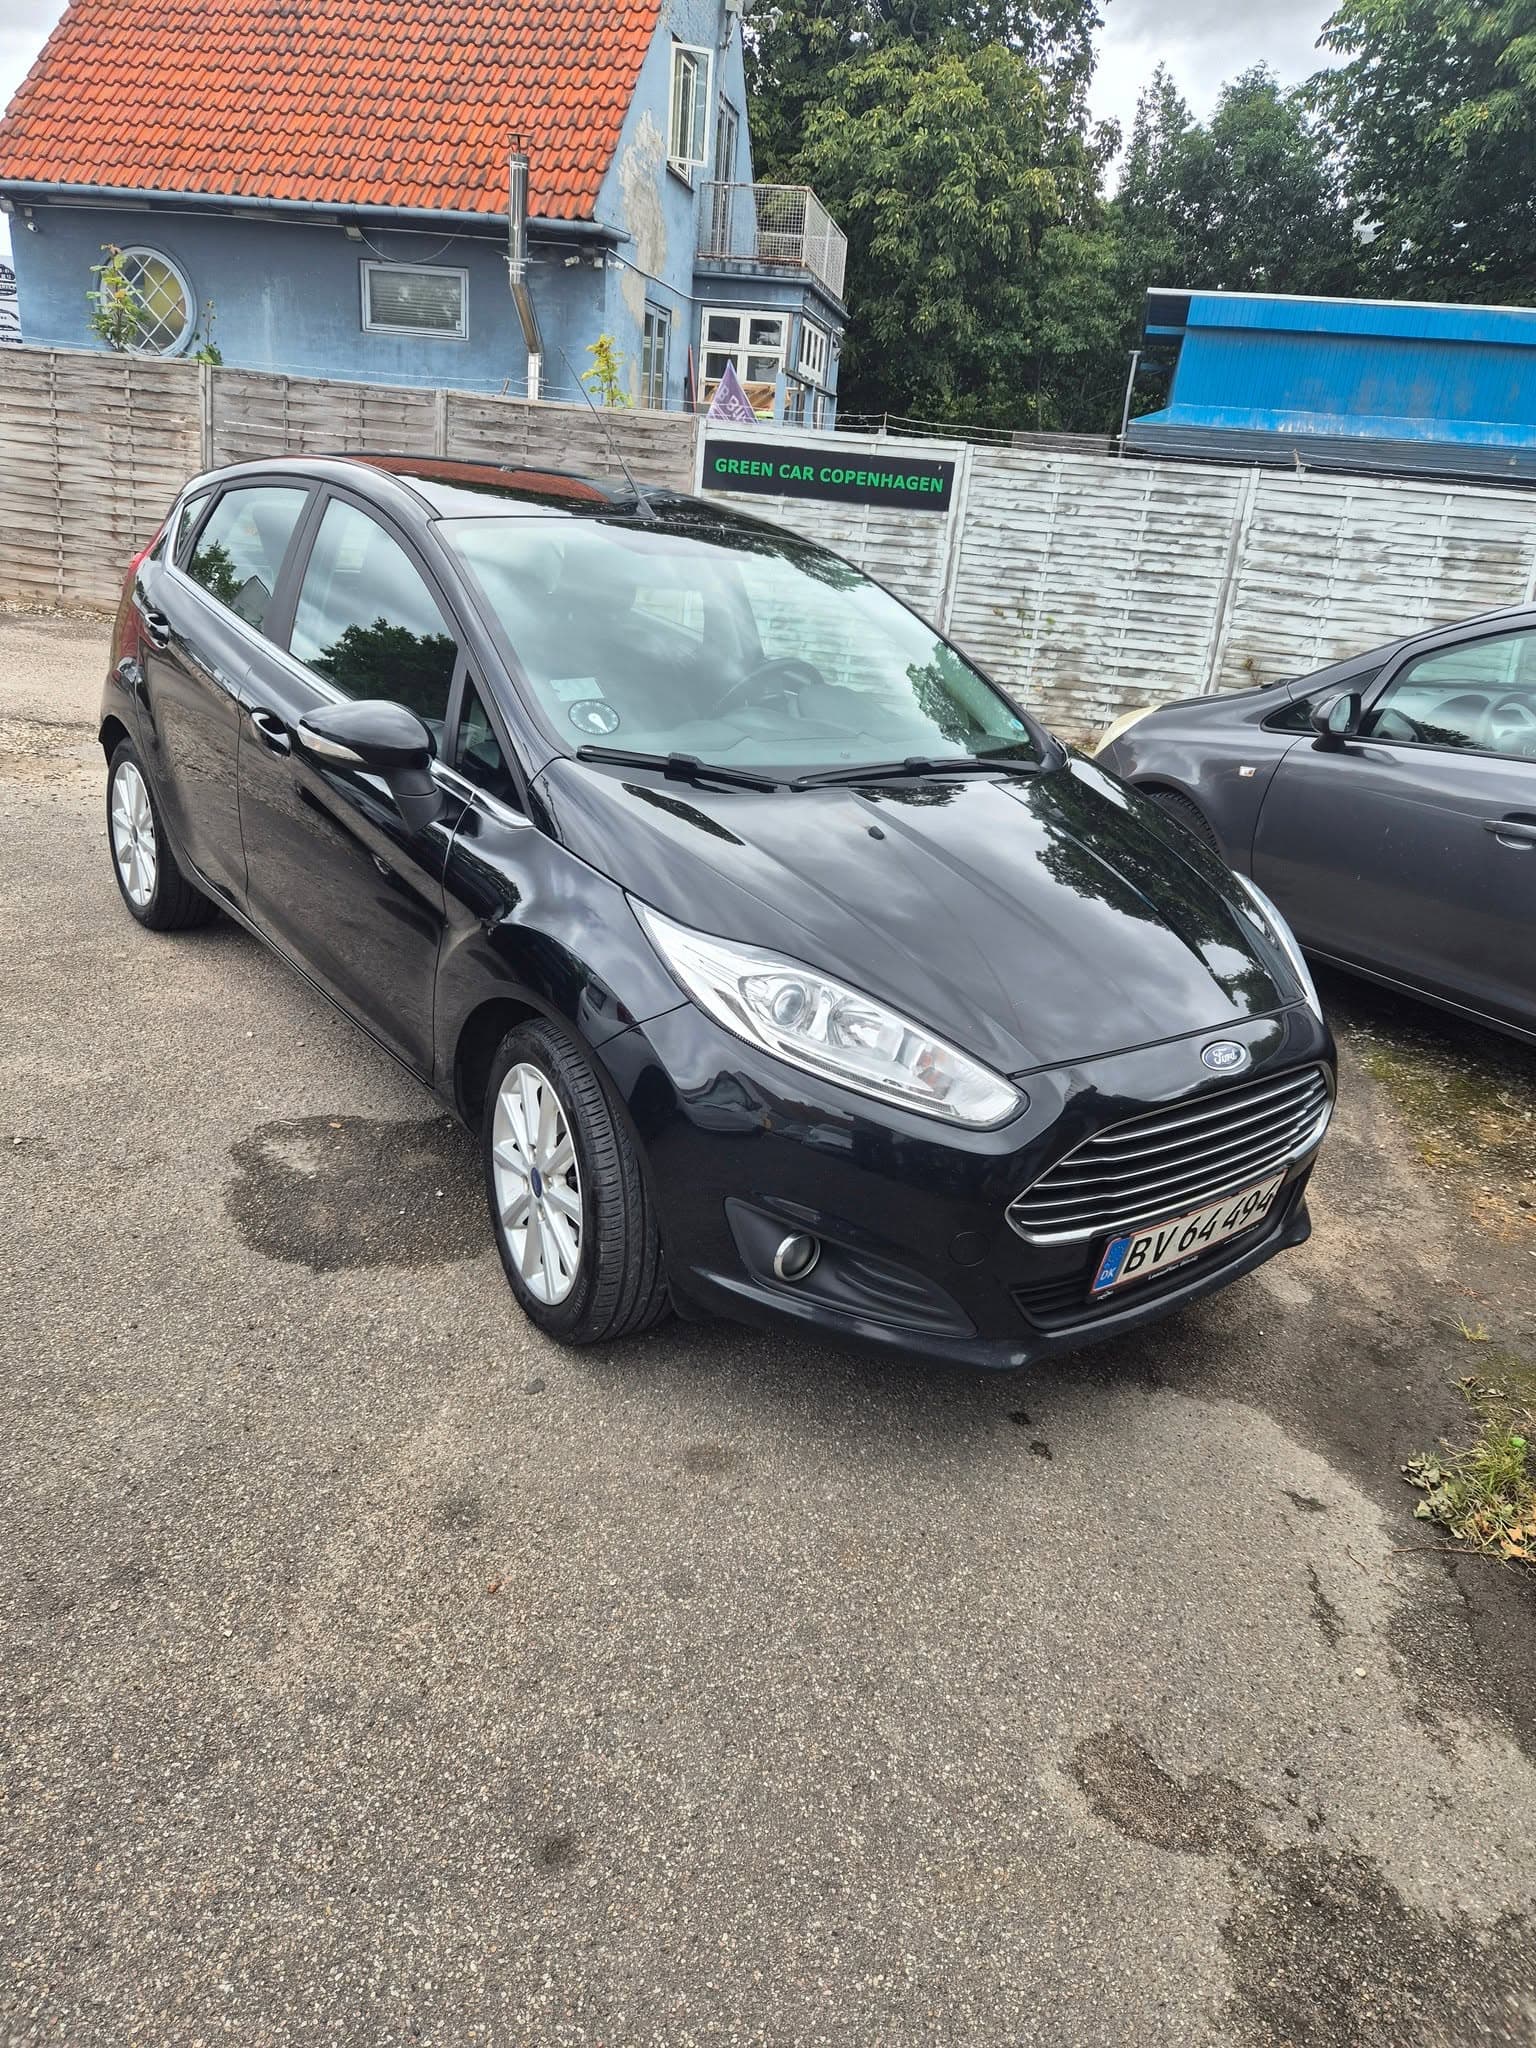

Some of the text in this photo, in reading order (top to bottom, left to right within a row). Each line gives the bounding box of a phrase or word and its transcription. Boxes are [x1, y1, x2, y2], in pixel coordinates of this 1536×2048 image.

[714, 458, 944, 493] GREEN CAR COPENHAGEN
[1212, 1047, 1238, 1064] Ford
[1123, 1226, 1179, 1275] BV
[1177, 1207, 1223, 1252] 64
[1221, 1179, 1281, 1230] 494
[1100, 1266, 1115, 1281] DK
